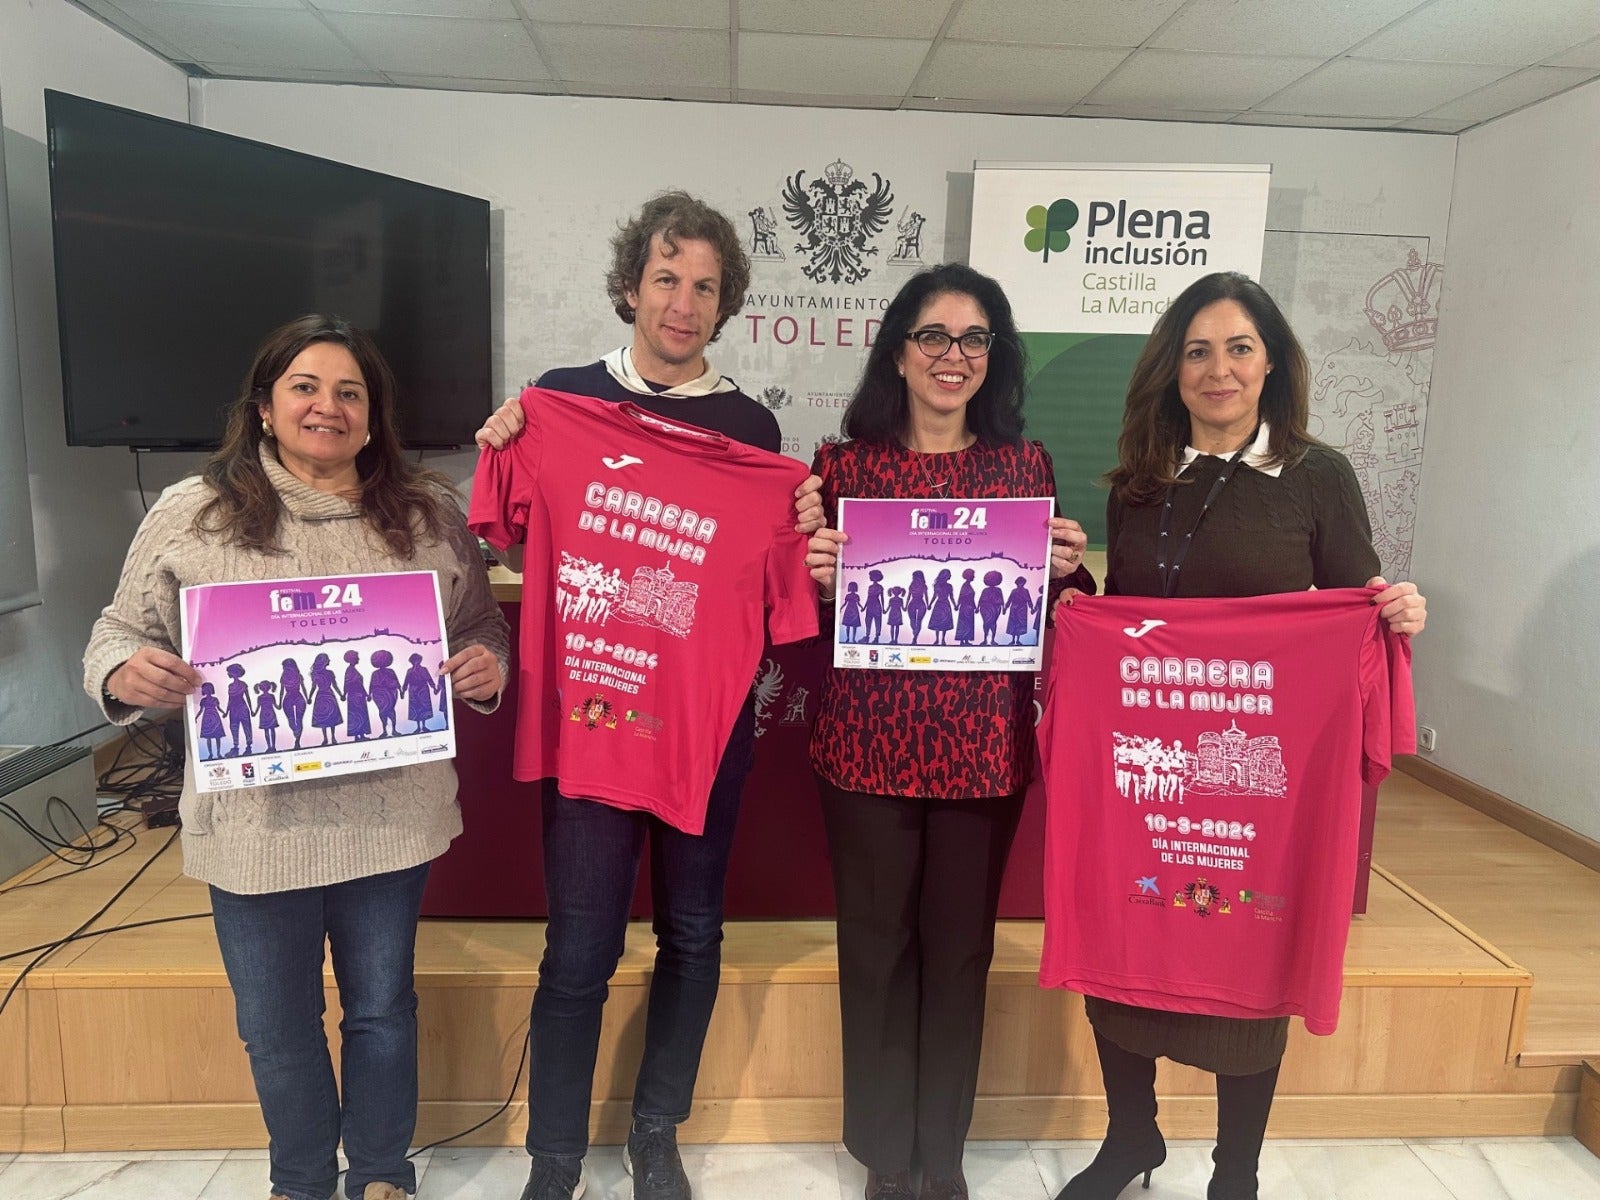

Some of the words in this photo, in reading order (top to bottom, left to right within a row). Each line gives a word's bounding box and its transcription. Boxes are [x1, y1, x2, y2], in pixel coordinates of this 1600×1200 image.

[1087, 200, 1211, 239] Plena
[1085, 240, 1208, 266] inclusión
[1082, 272, 1157, 291] Castilla
[745, 294, 890, 311] AYUNTAMIENTO
[1081, 296, 1102, 314] La
[1108, 296, 1177, 315] Manch
[745, 315, 883, 348] TOLED
[807, 397, 850, 408] TOLED
[584, 481, 718, 544] CARRERA
[578, 510, 607, 533] DE
[609, 518, 637, 542] LA
[637, 527, 707, 566] MUJER
[923, 537, 972, 545] TOLEDO
[290, 616, 349, 628] TOLEDO
[565, 632, 659, 670] 10-3-2024
[564, 655, 580, 668] DÍA
[582, 659, 647, 685] INTERNACIONAL
[569, 669, 582, 681] DE
[582, 671, 598, 684] LAS
[599, 674, 640, 695] MUJERES
[1119, 655, 1274, 690] CARRERA
[1121, 687, 1151, 708] DE
[1155, 688, 1185, 710] LA
[1189, 690, 1274, 716] MUJER
[1144, 813, 1257, 841] 10-3-2024
[1152, 837, 1169, 850] DÍA
[1170, 839, 1250, 859] INTERNACIONAL
[1161, 852, 1174, 863] DE
[1176, 853, 1194, 866] LAS
[1196, 856, 1244, 872] MUJERES
